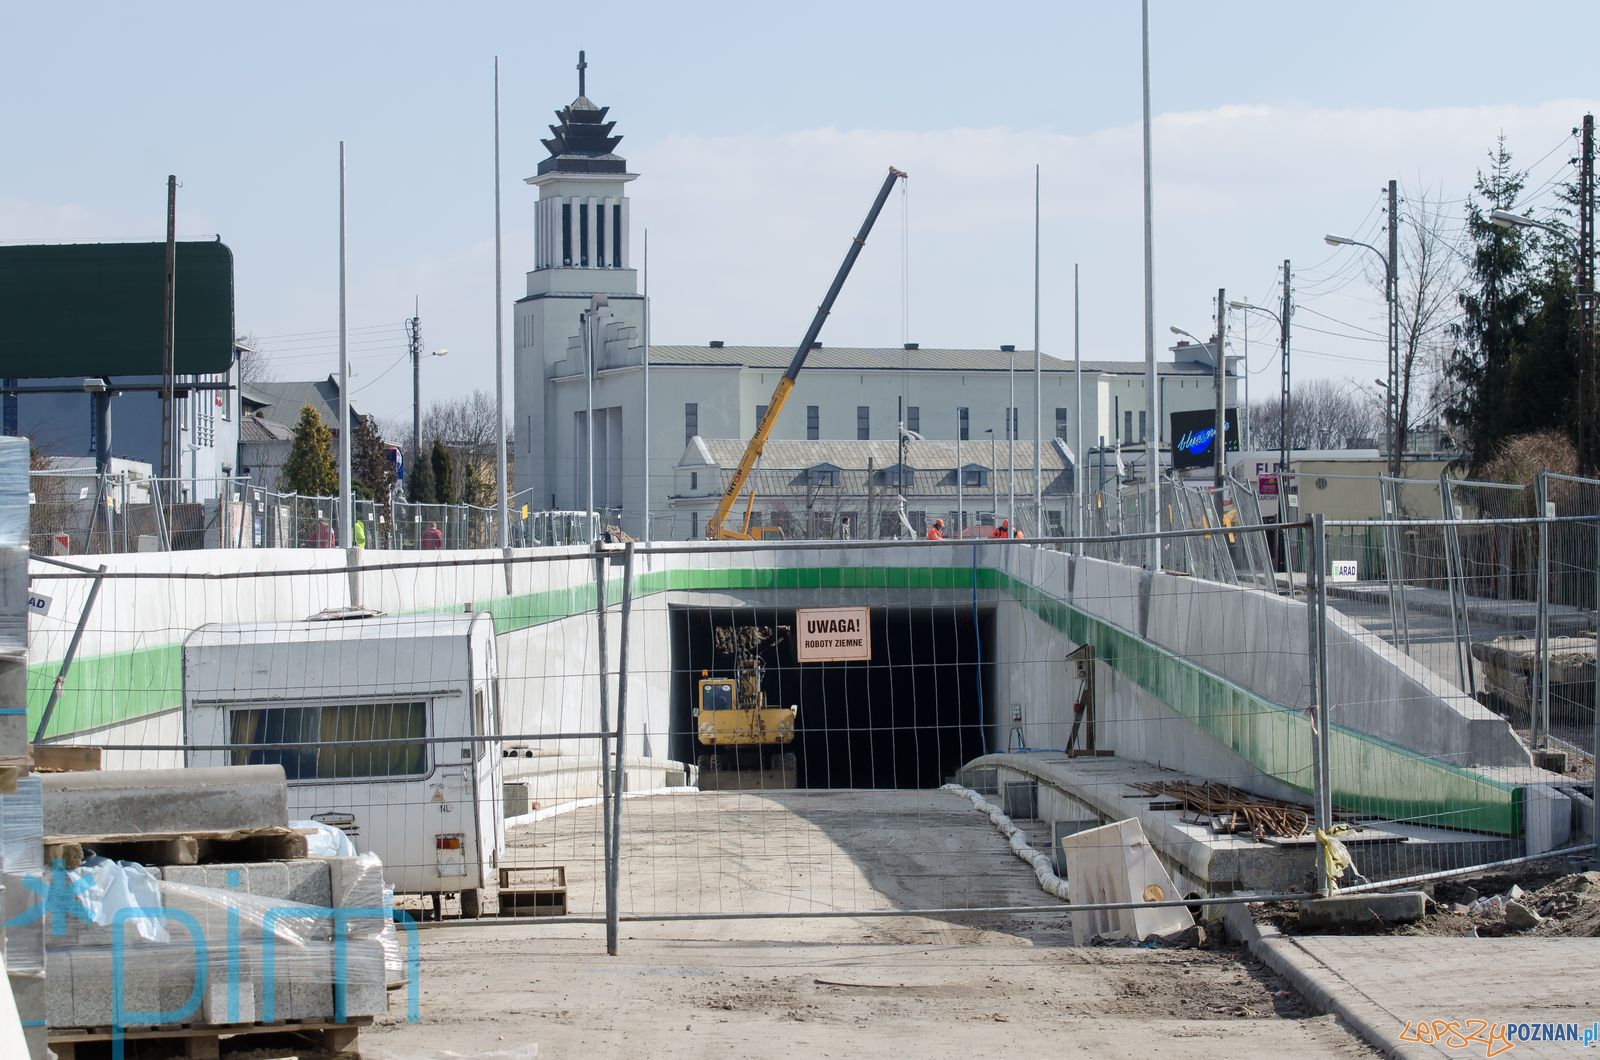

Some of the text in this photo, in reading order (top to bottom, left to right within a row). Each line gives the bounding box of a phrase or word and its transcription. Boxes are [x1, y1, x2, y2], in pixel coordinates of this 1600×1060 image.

[1177, 430, 1203, 451] blue
[727, 469, 743, 497] INTOP
[807, 618, 860, 634] UWAGA!
[805, 638, 863, 648] ROBOTY ZIEMNE
[440, 804, 451, 813] NL
